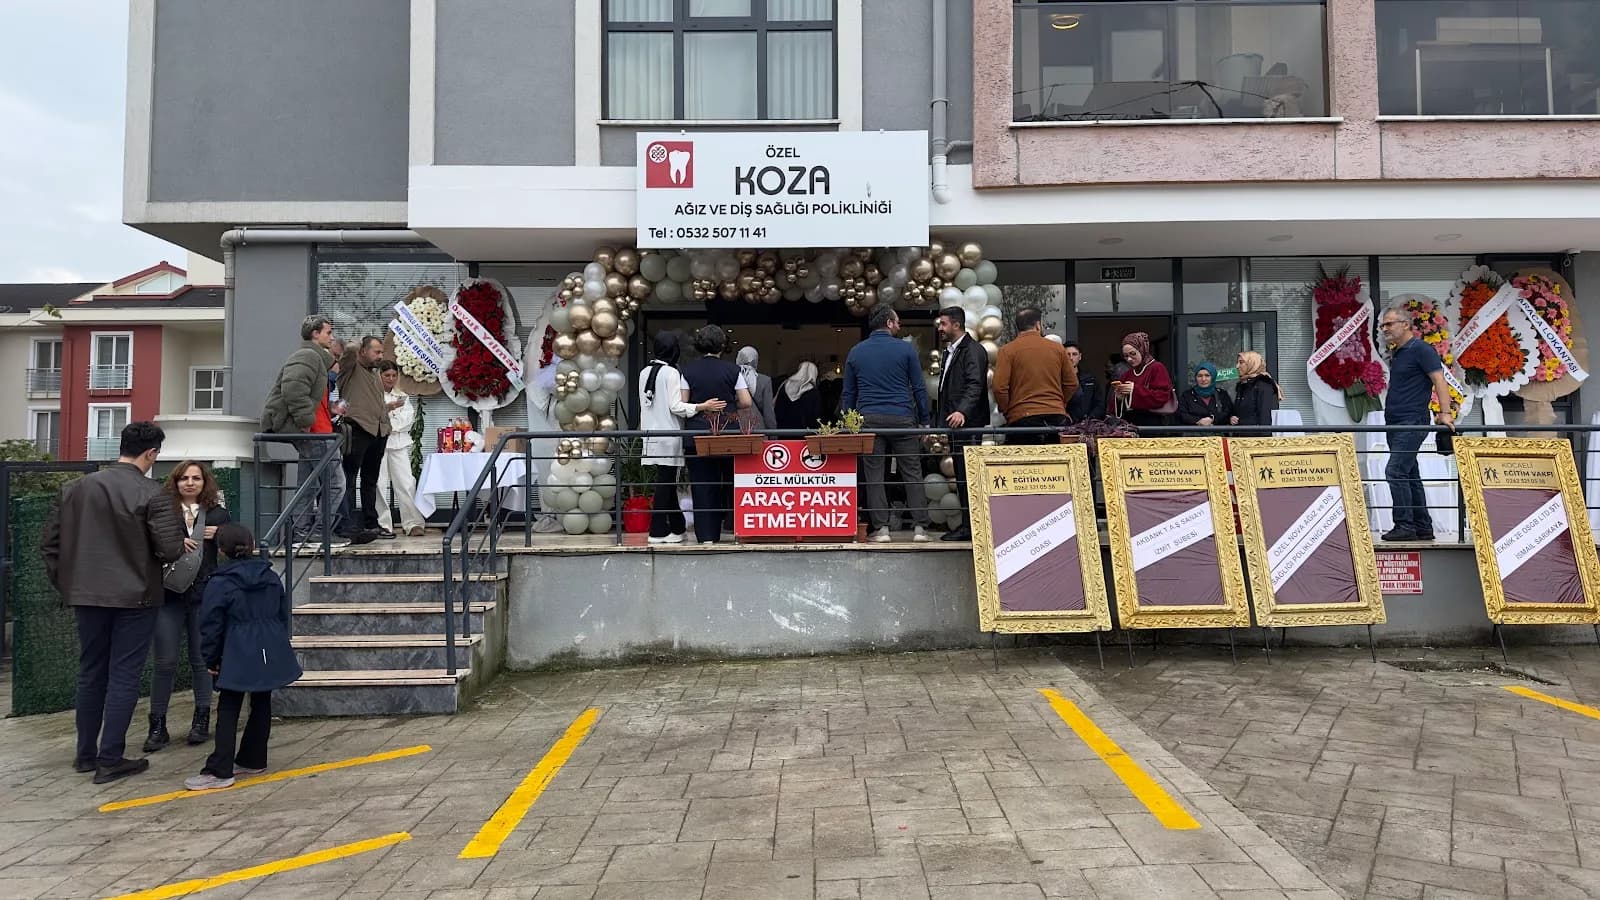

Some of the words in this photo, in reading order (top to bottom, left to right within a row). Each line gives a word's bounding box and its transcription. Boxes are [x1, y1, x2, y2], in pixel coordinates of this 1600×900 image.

[766, 145, 800, 158] ÖZEL
[735, 166, 830, 196] KOZA
[674, 202, 706, 215] AĞIZ
[709, 204, 727, 215] VE
[730, 201, 752, 218] DİŞ
[756, 201, 810, 215] SAĞLIĞI
[812, 200, 892, 215] POLİKLİNİĞİ
[649, 227, 667, 239] Tel
[676, 227, 710, 239] 0532
[712, 227, 737, 239] 507
[739, 227, 750, 238] 11
[752, 227, 766, 238] 41
[1337, 323, 1356, 341] ADNAN
[755, 475, 782, 484] ÖZEL
[785, 474, 836, 484] MÜLKTÜR
[1013, 475, 1040, 483] EĞİTİM
[1280, 467, 1308, 475] EĞİTİM
[740, 491, 795, 510] ARAÇ
[800, 491, 851, 506] PARK
[744, 509, 848, 528] ETMEYİNİZ
[1136, 530, 1164, 547] AKBANK
[1288, 524, 1304, 542] NOVA
